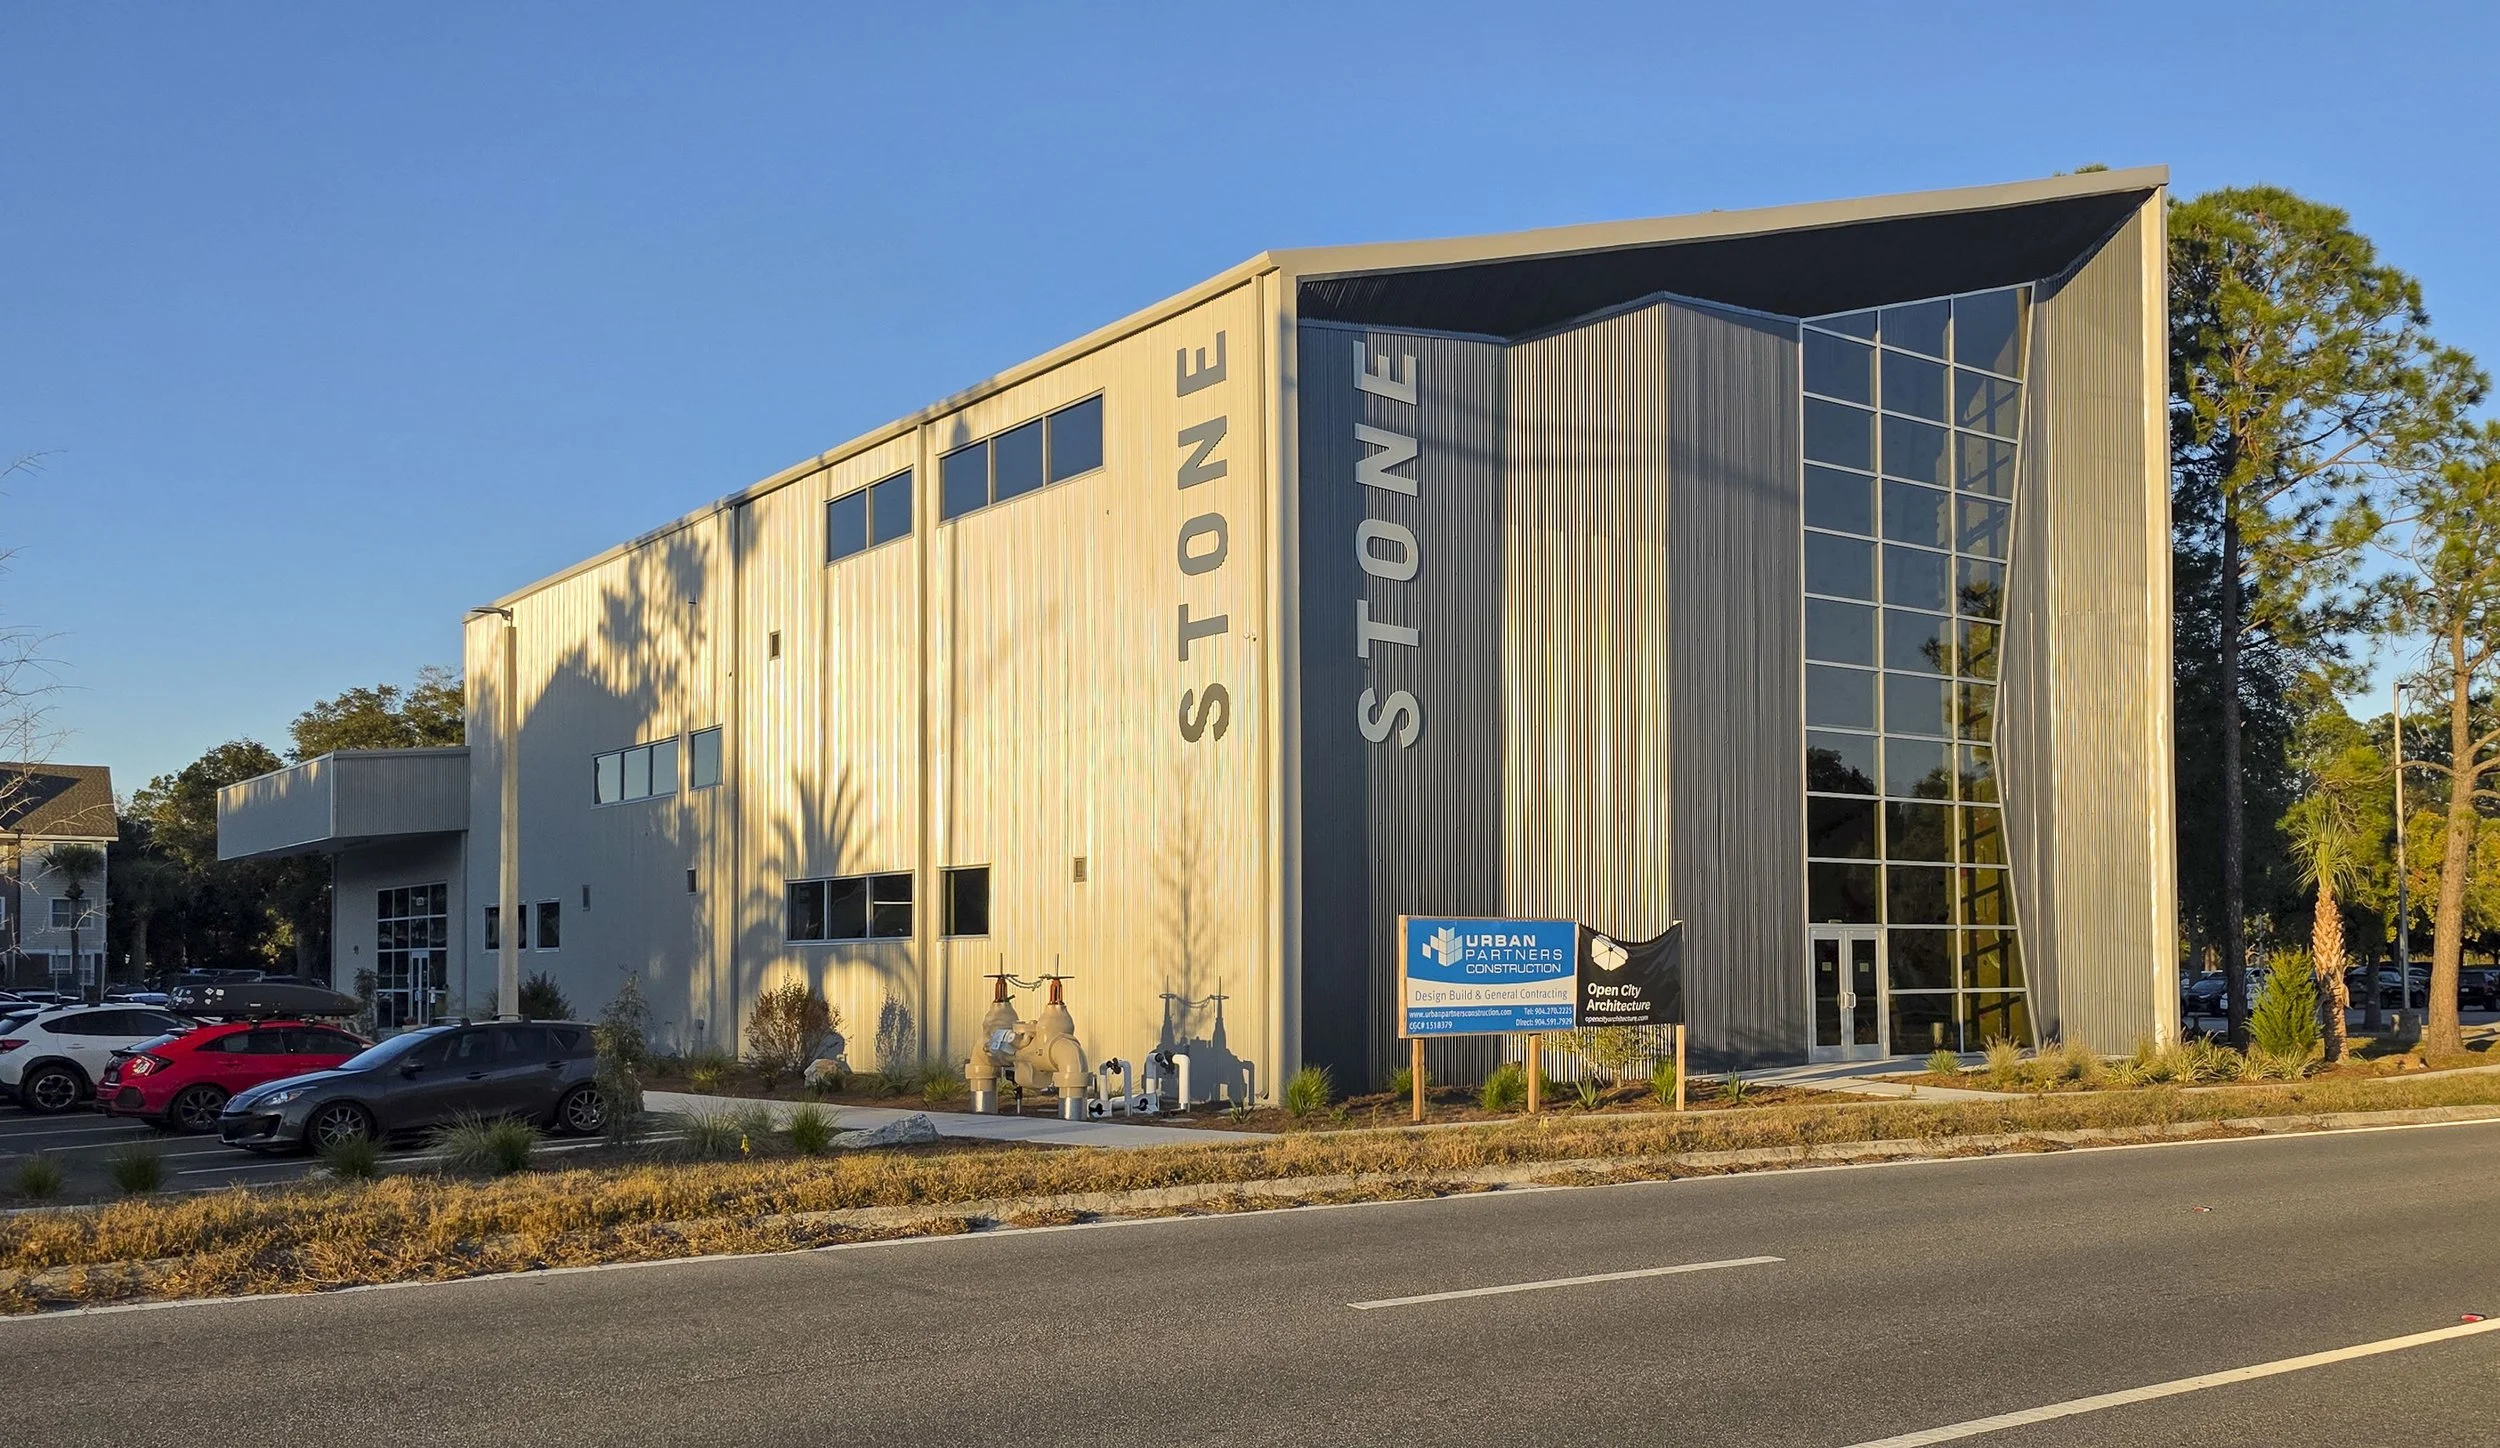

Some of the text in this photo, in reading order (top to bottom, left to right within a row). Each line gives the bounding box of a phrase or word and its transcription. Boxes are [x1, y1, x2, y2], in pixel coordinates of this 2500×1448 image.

[1177, 330, 1230, 743] STONE
[1353, 340, 1420, 748] STONE
[1466, 934, 1536, 947] URBAN
[1465, 949, 1563, 961] PARTNERS
[1466, 963, 1561, 974] CONSTRUCTION
[1415, 988, 1568, 1002] Design Build & General Contracting
[1587, 982, 1642, 999] Open City
[1586, 998, 1651, 1012] Architecture
[1409, 1008, 1512, 1018] www.urbanpartnersconstruction.com
